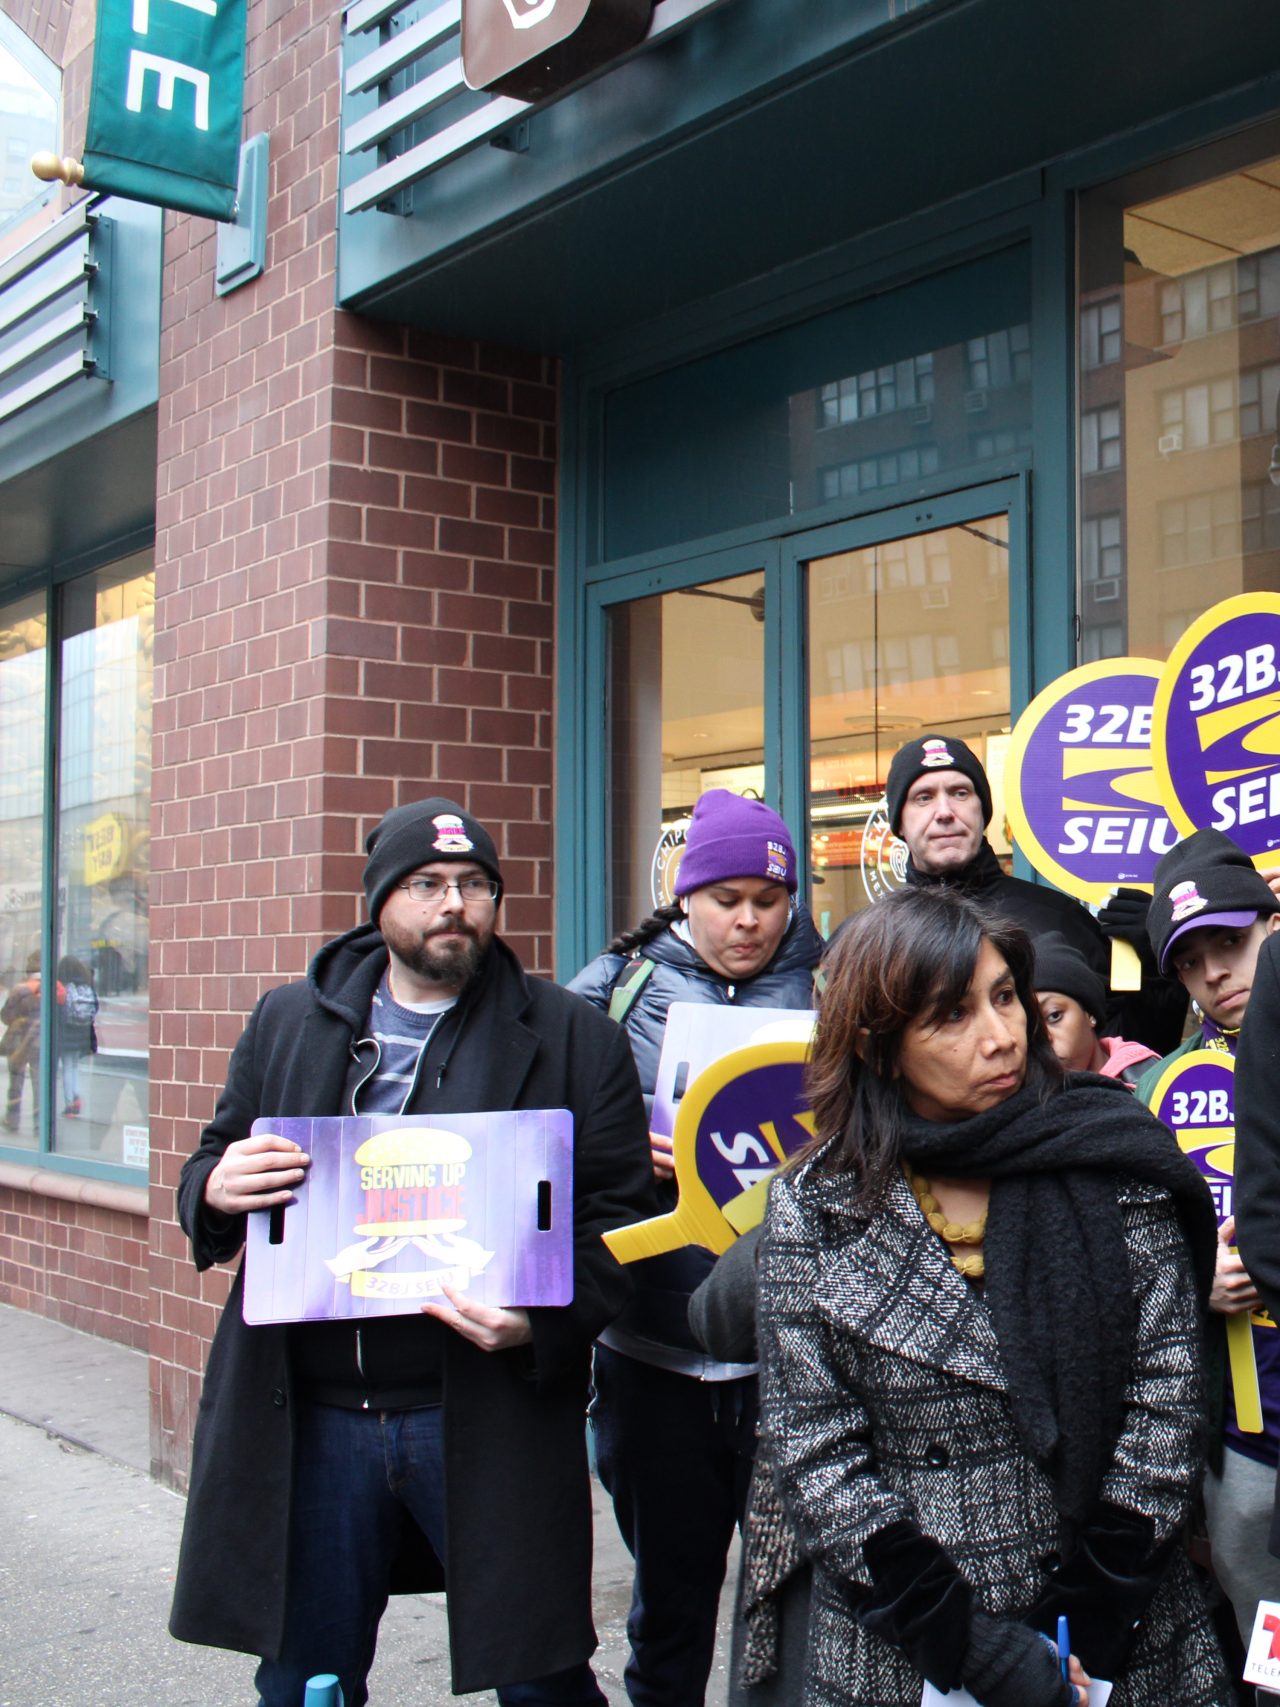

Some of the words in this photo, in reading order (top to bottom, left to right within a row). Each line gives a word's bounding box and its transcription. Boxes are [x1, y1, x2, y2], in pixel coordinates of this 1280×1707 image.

[1058, 704, 1154, 743] 32B
[1058, 816, 1185, 855] SEIU
[1171, 1089, 1234, 1124] 32B
[361, 1165, 437, 1191] SERVING
[442, 1163, 466, 1187] UP
[356, 1185, 466, 1224] JUSTICE
[366, 1276, 409, 1295] 32BJ
